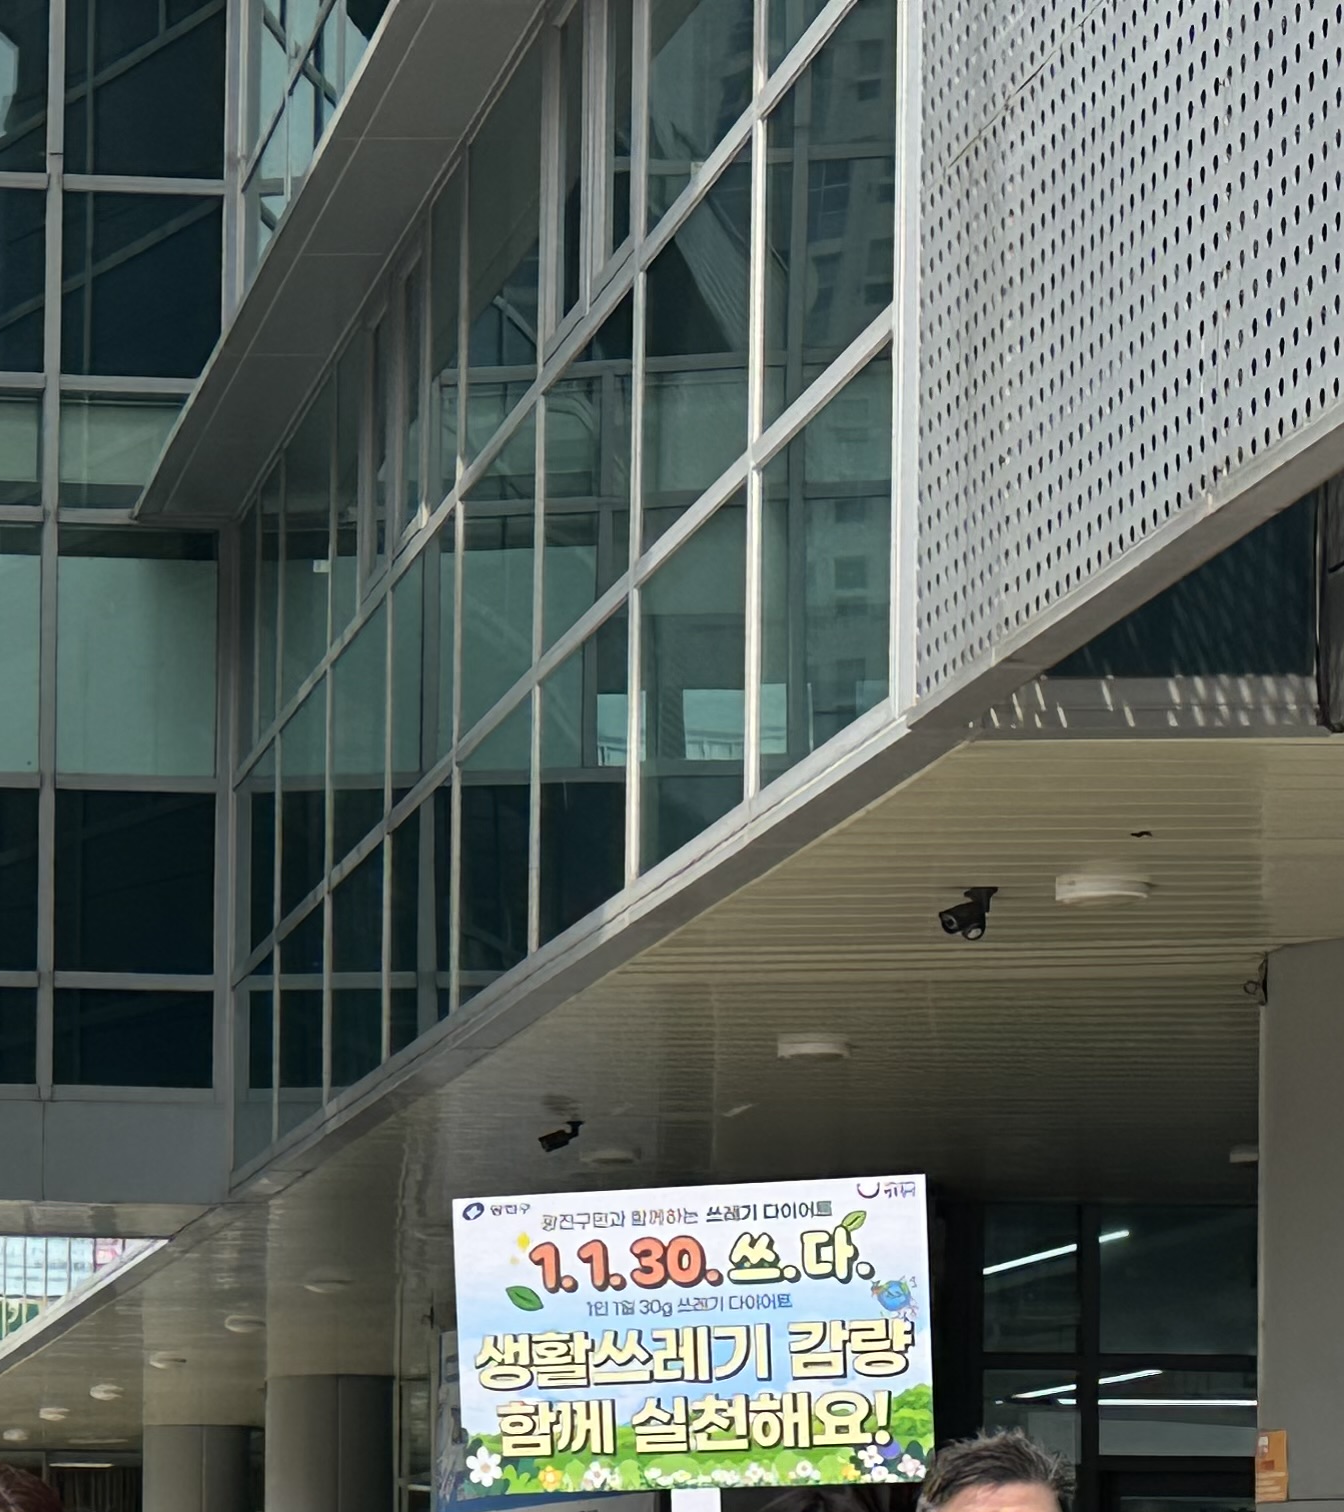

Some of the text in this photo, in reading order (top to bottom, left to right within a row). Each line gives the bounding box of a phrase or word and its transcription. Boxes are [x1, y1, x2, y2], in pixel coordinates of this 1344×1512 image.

[705, 1204, 758, 1222] 쓰레기
[763, 1199, 833, 1219] 다이어트
[476, 1317, 914, 1390] 생활쓰레기 감량
[496, 1390, 895, 1457] 함께 실천해요!
